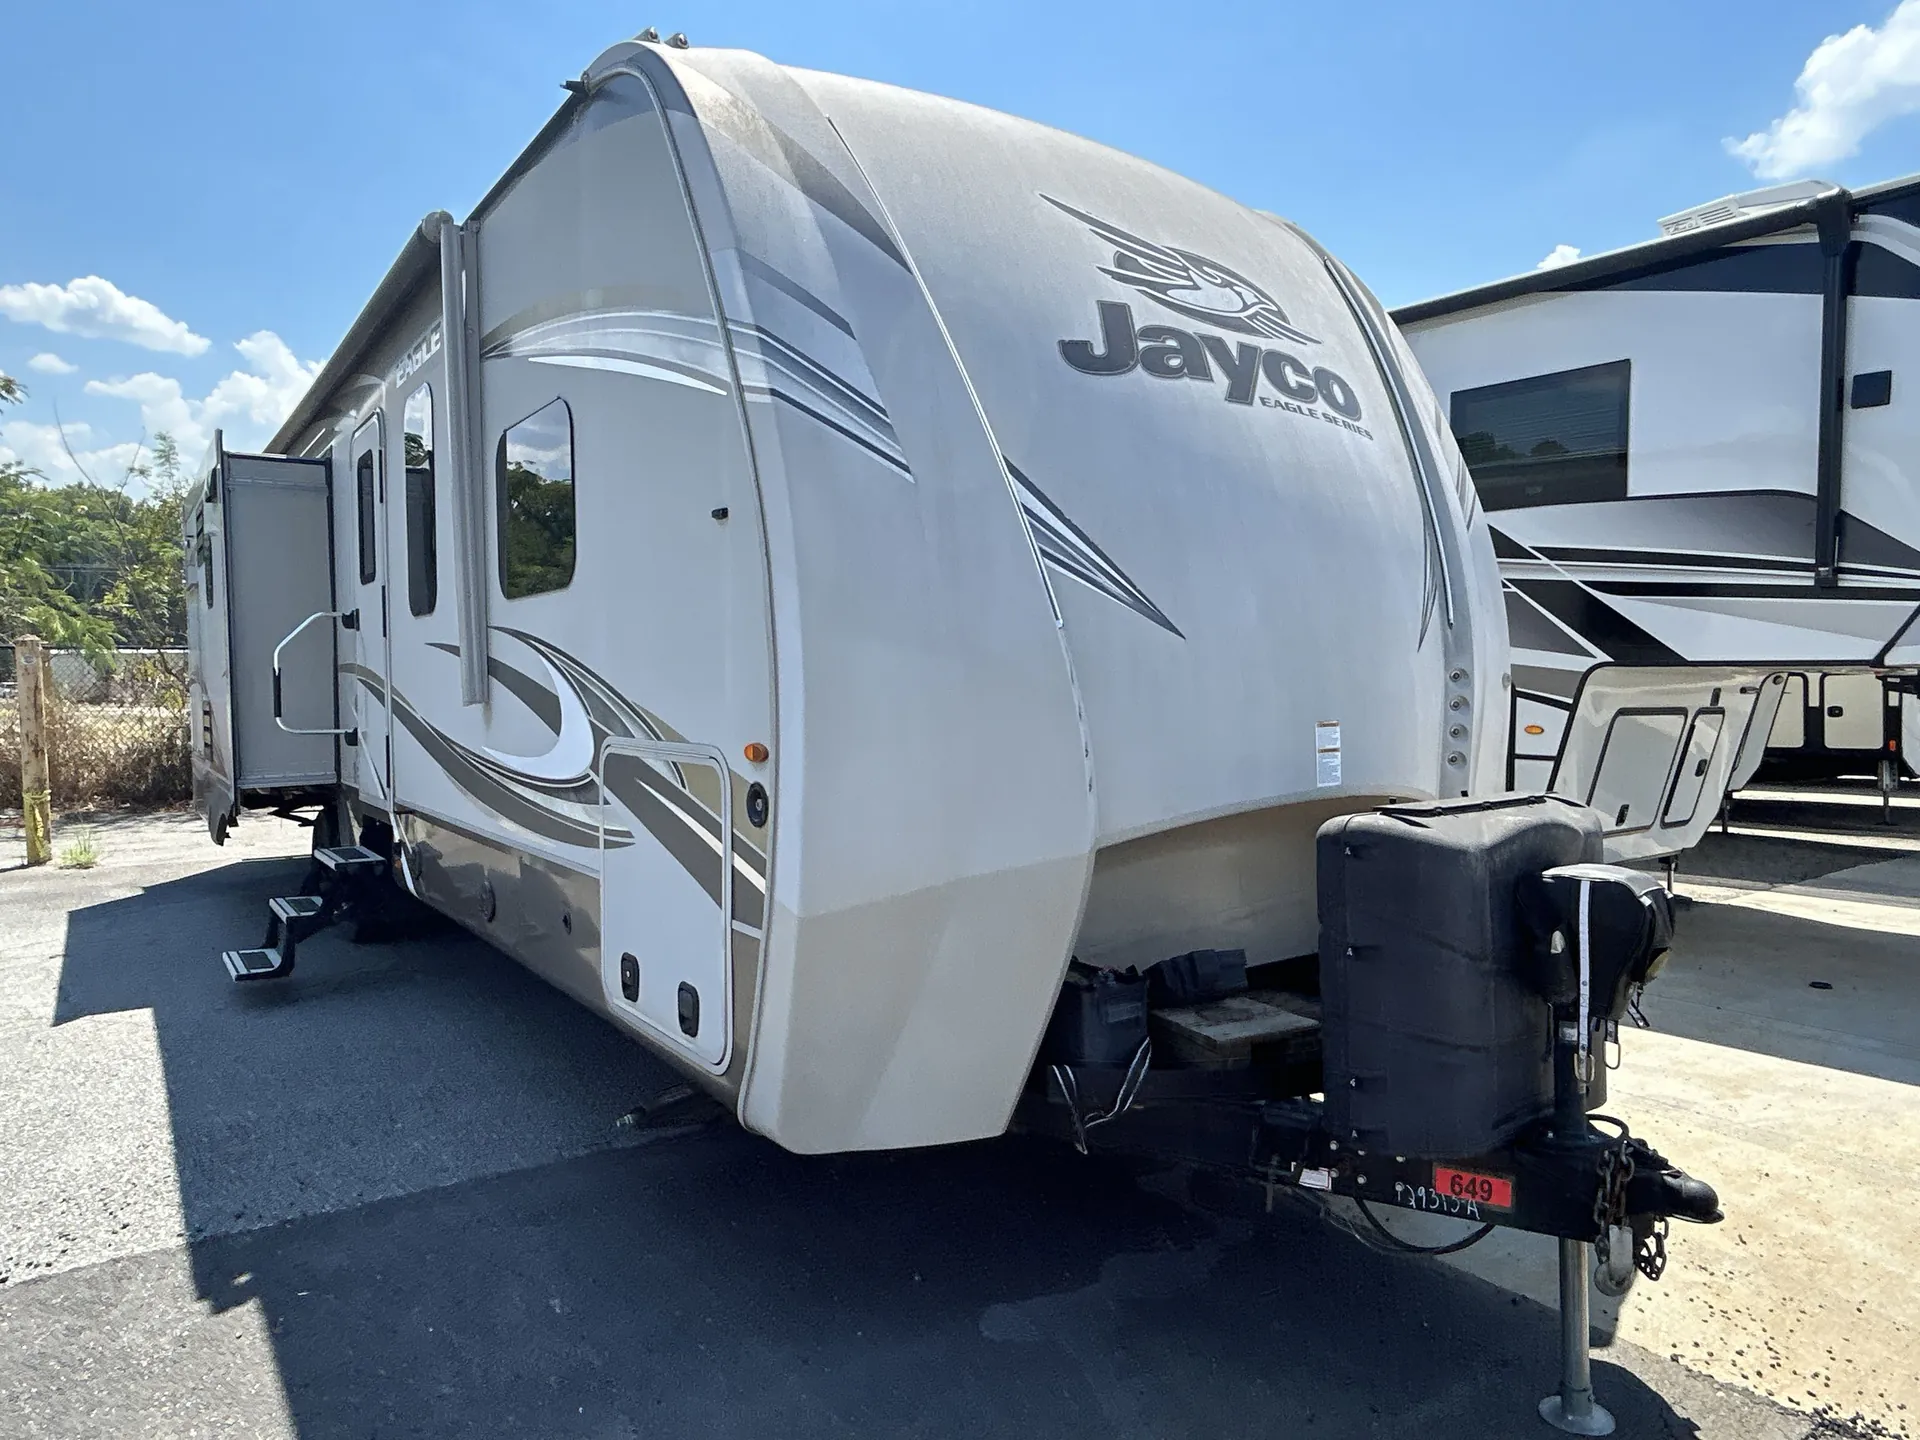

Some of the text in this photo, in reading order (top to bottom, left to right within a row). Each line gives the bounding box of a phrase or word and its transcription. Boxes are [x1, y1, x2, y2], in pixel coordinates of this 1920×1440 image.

[395, 317, 442, 389] EAGLE
[1057, 299, 1362, 422] Jayco
[1259, 396, 1374, 441] EAGLE SERIES
[1450, 1174, 1493, 1201] 649
